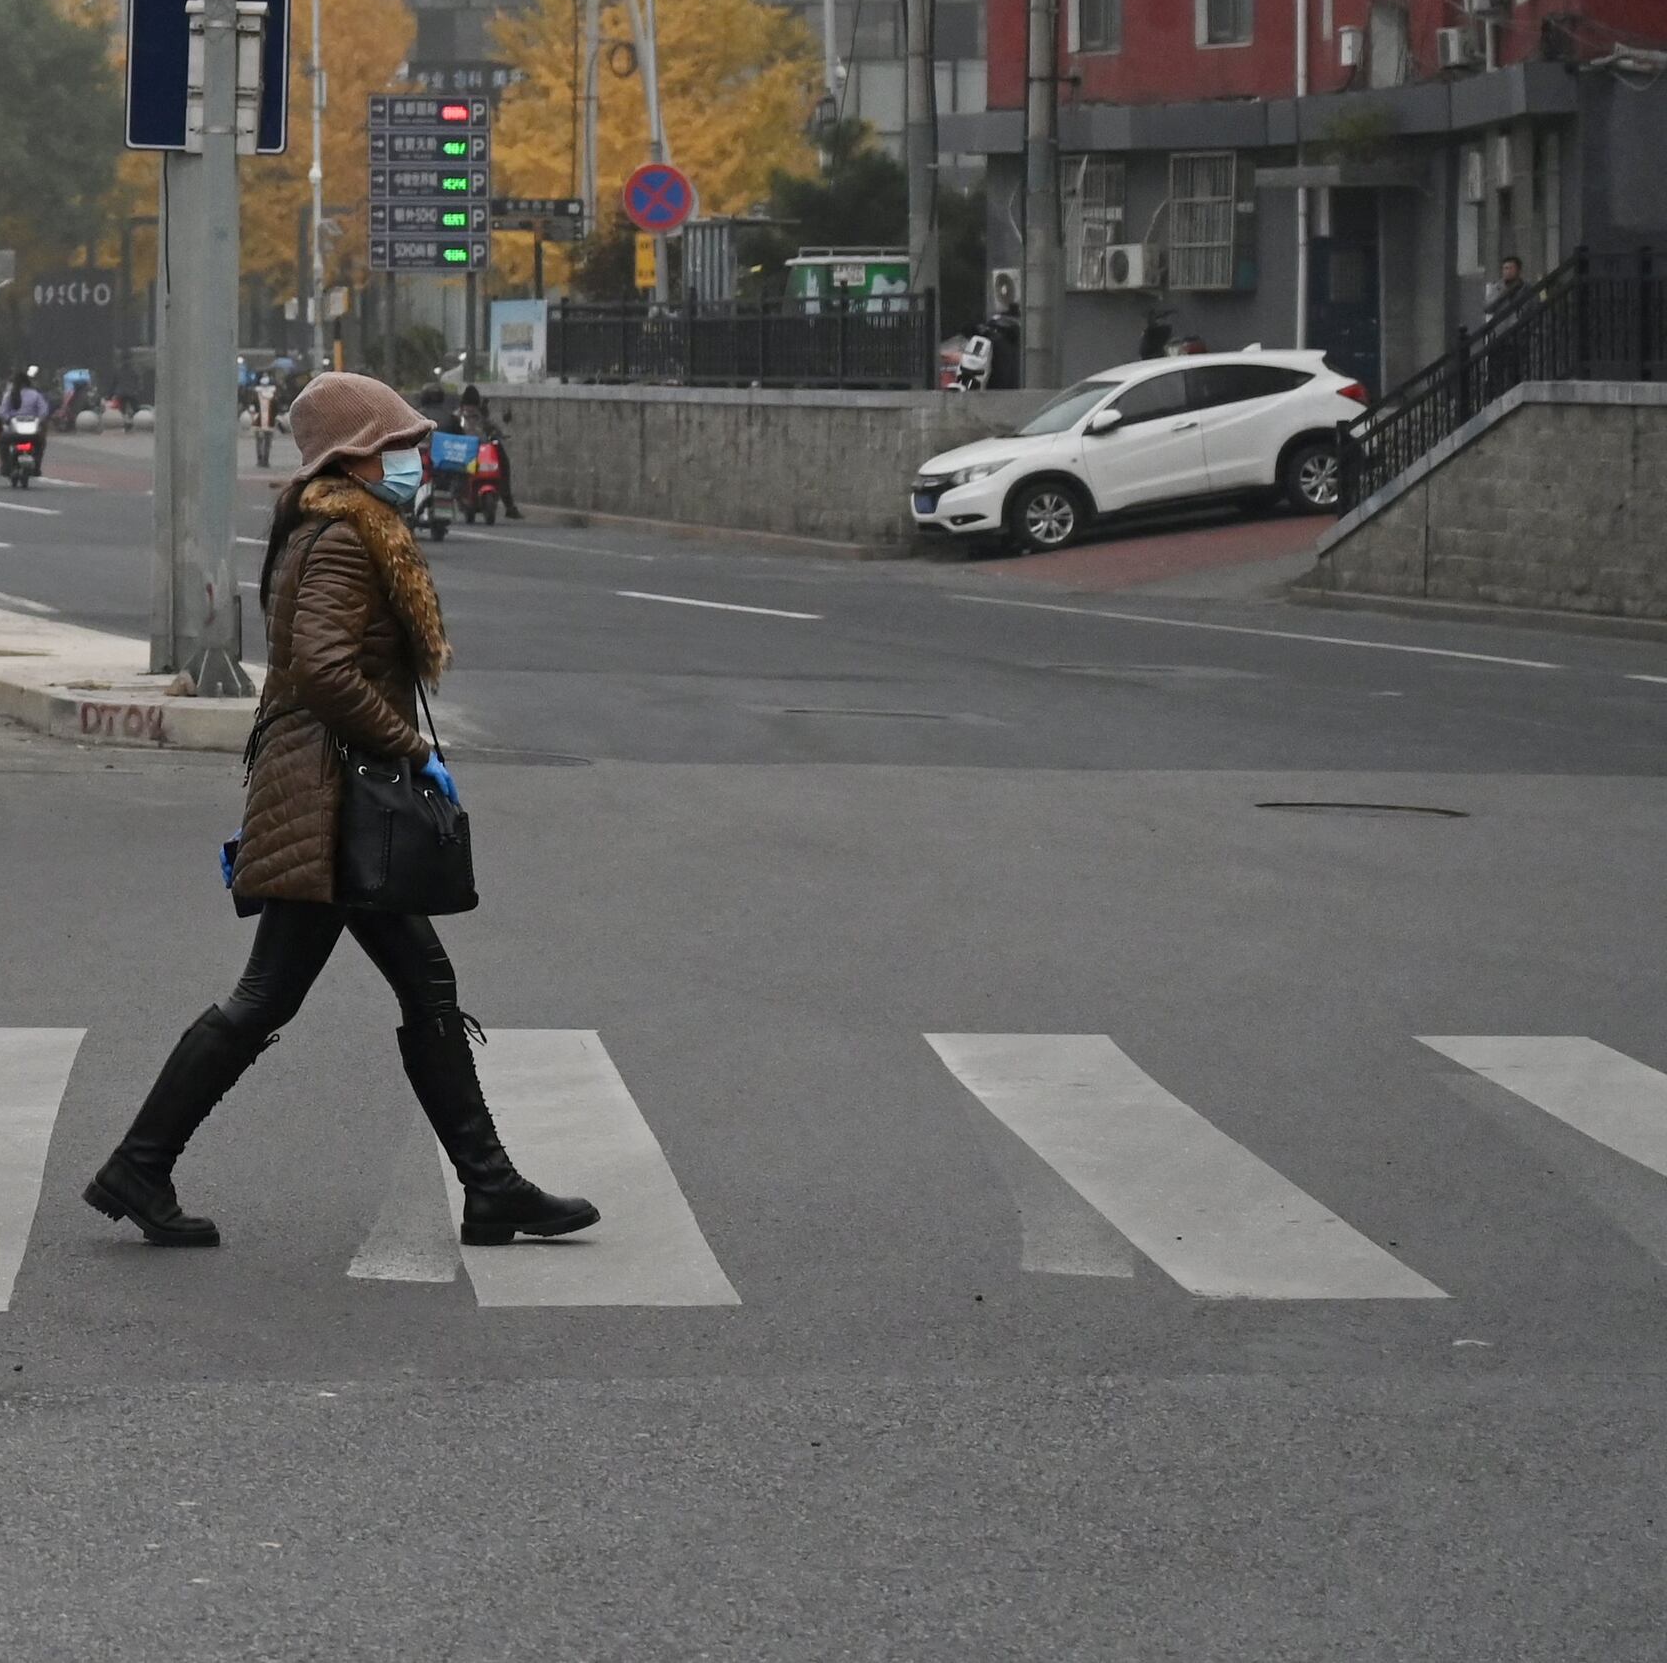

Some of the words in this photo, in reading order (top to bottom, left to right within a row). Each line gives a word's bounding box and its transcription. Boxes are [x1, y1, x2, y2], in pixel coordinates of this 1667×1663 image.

[471, 102, 485, 123] P
[471, 137, 485, 158] P
[471, 172, 485, 193] P
[471, 208, 485, 228] P
[471, 243, 485, 264] P
